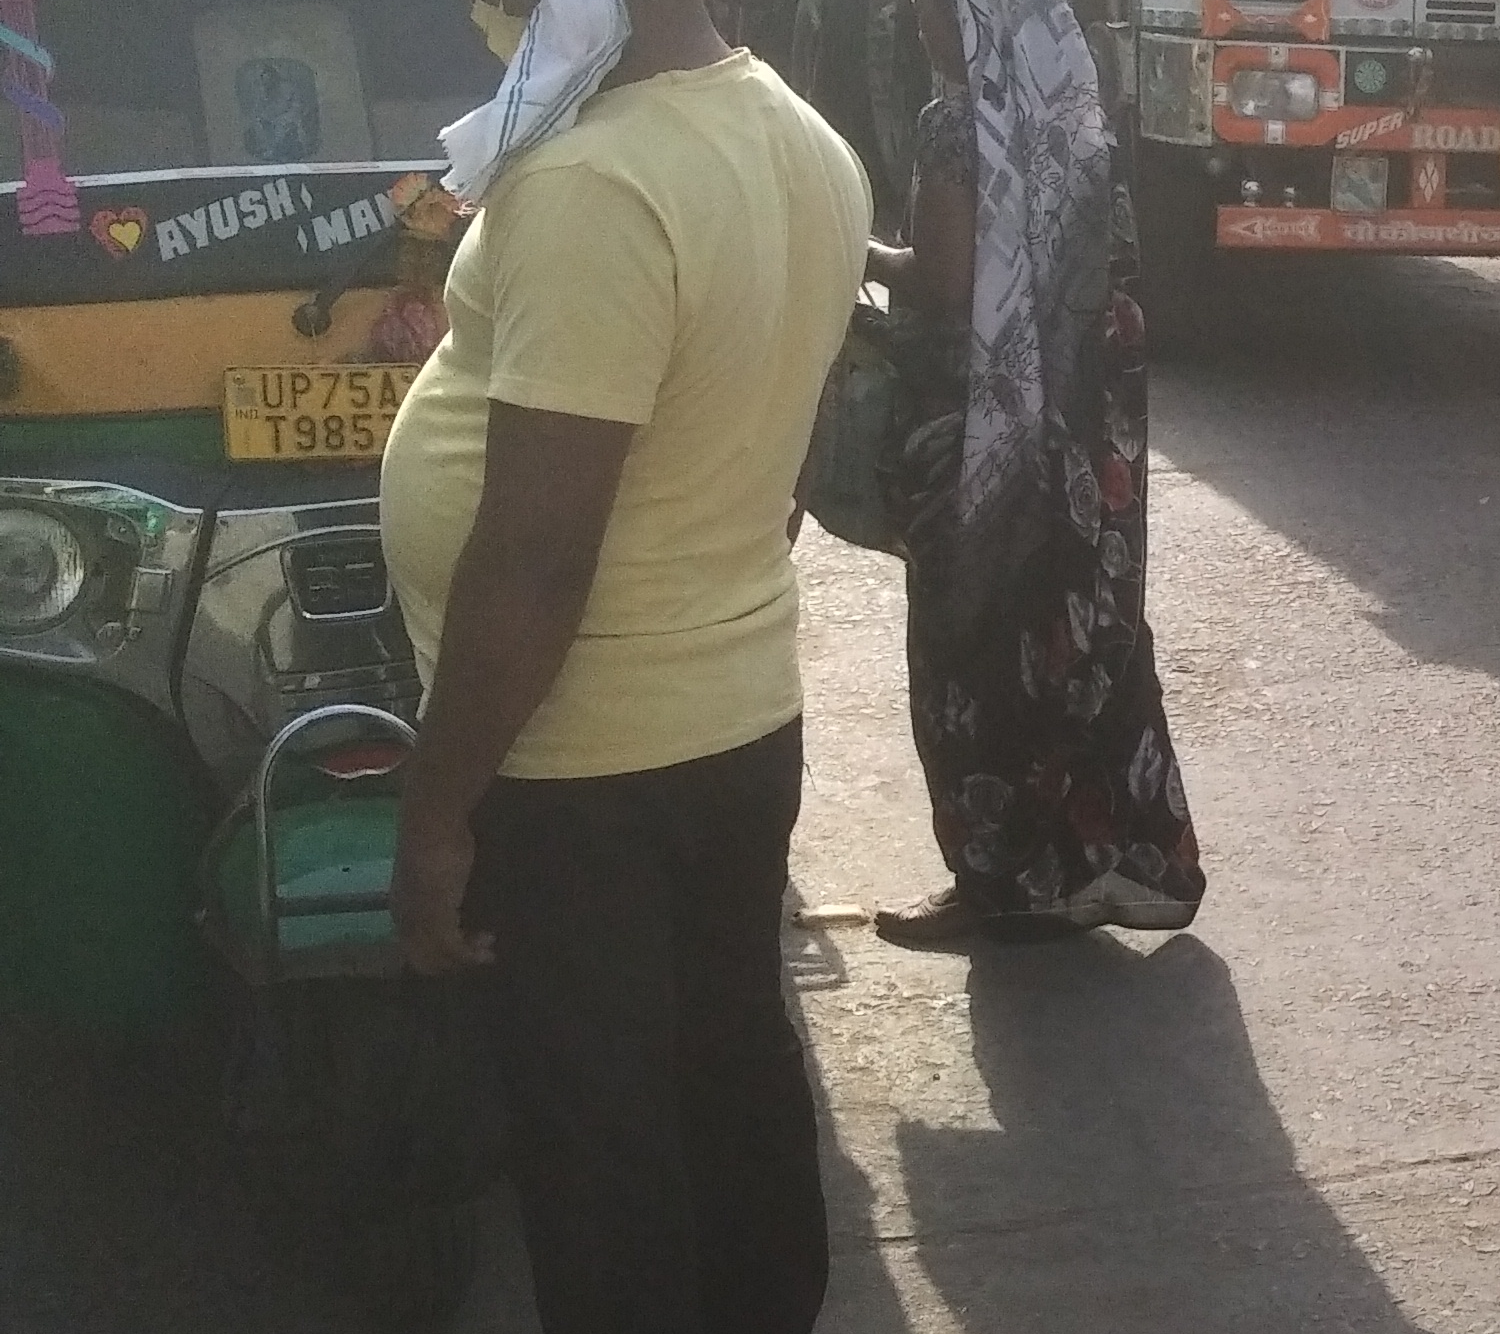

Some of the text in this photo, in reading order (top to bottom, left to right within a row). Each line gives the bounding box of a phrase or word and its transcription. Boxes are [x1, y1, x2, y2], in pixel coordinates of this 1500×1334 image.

[1334, 112, 1404, 149] SUPER
[1411, 123, 1500, 152] ROAD
[155, 178, 297, 262] AYUSH
[262, 371, 400, 410] UP75A
